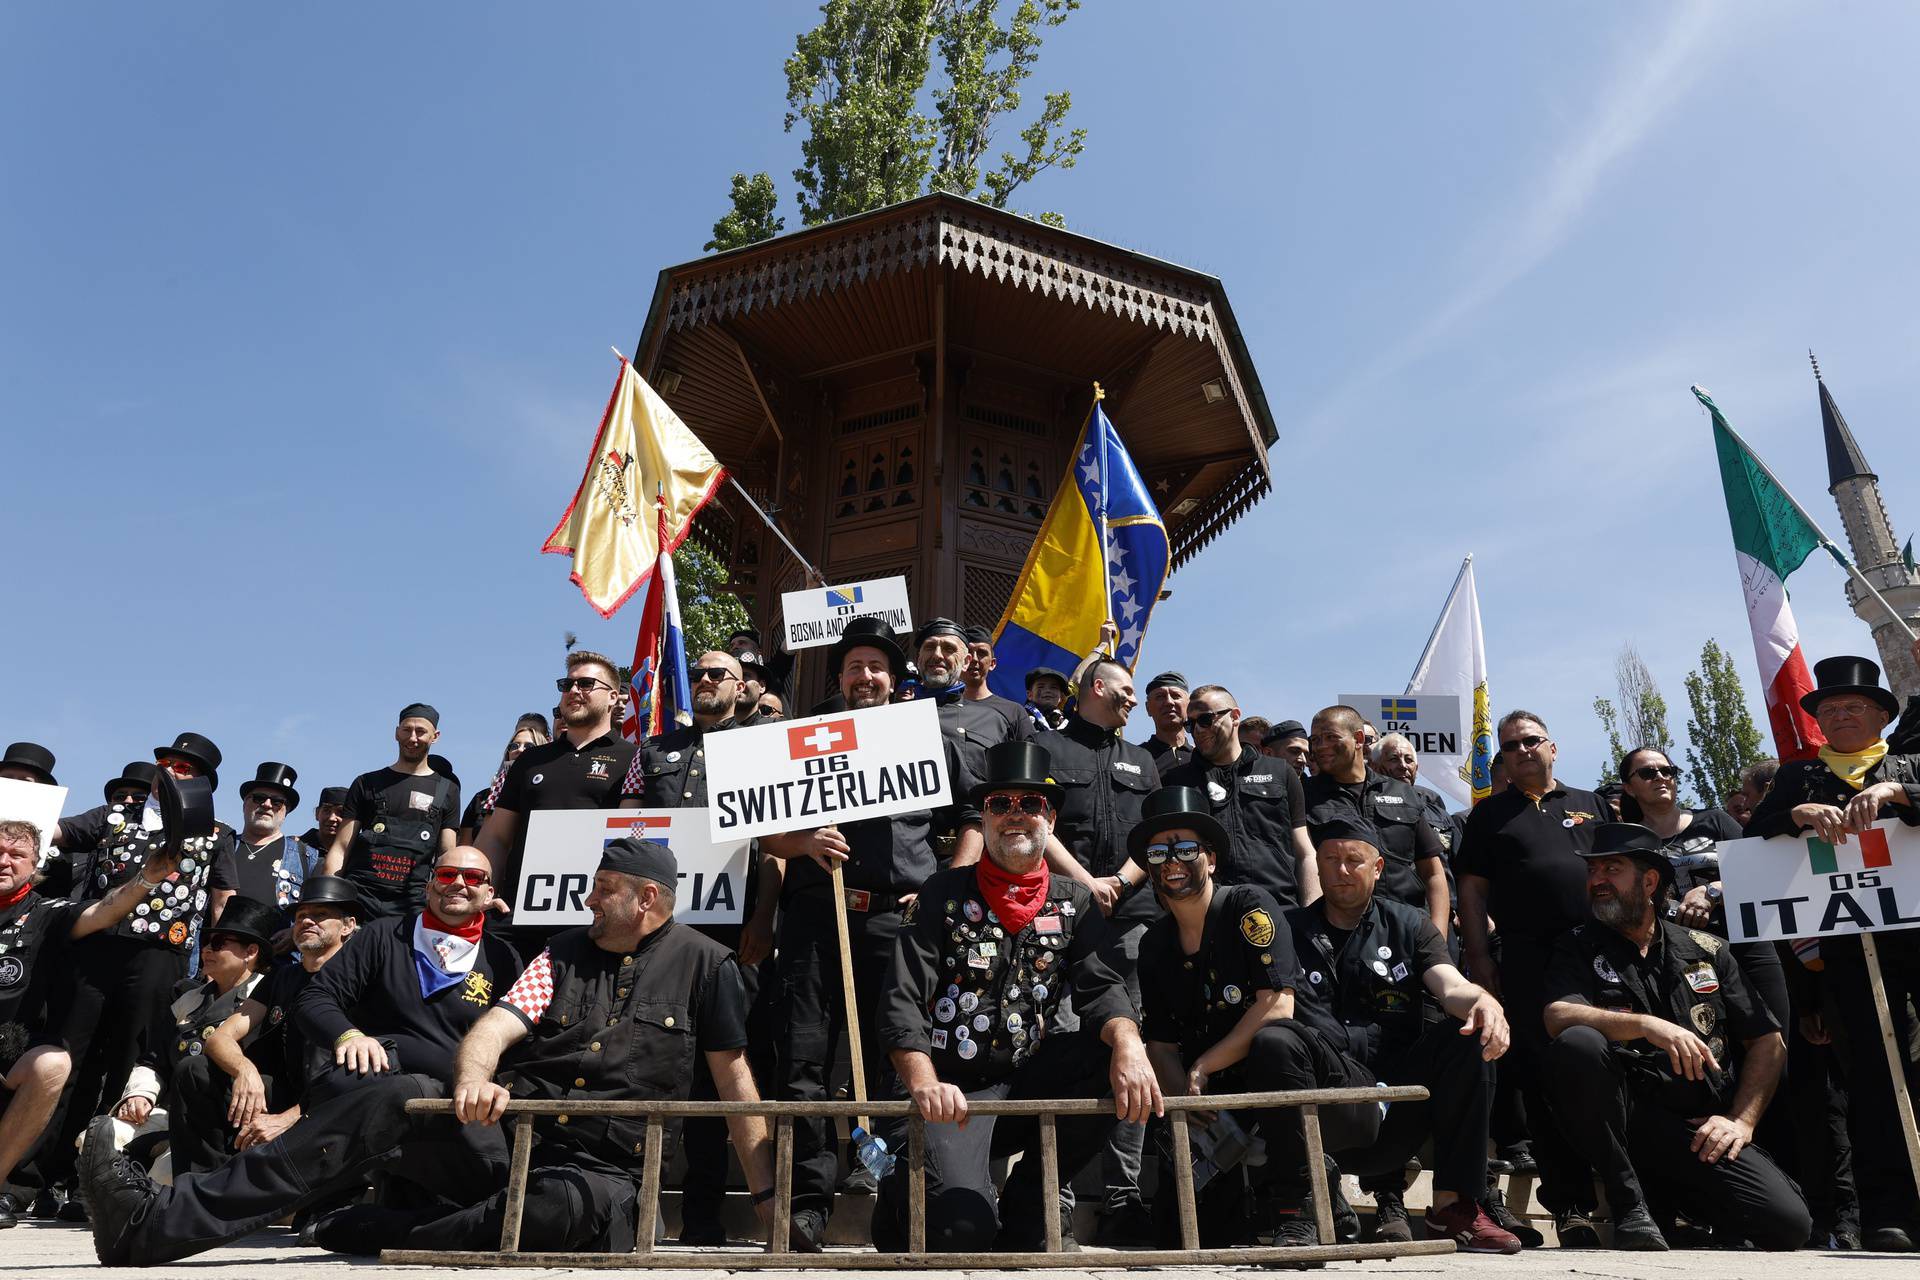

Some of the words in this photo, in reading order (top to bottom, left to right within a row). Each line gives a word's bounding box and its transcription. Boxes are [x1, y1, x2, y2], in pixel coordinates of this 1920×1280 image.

[837, 605, 855, 615] 01
[790, 620, 824, 643] BOSNIA
[826, 617, 843, 637] AND
[1387, 721, 1410, 731] 04
[804, 754, 850, 777] 06
[717, 759, 942, 829] SWITZERLAND
[1829, 870, 1881, 891] 05
